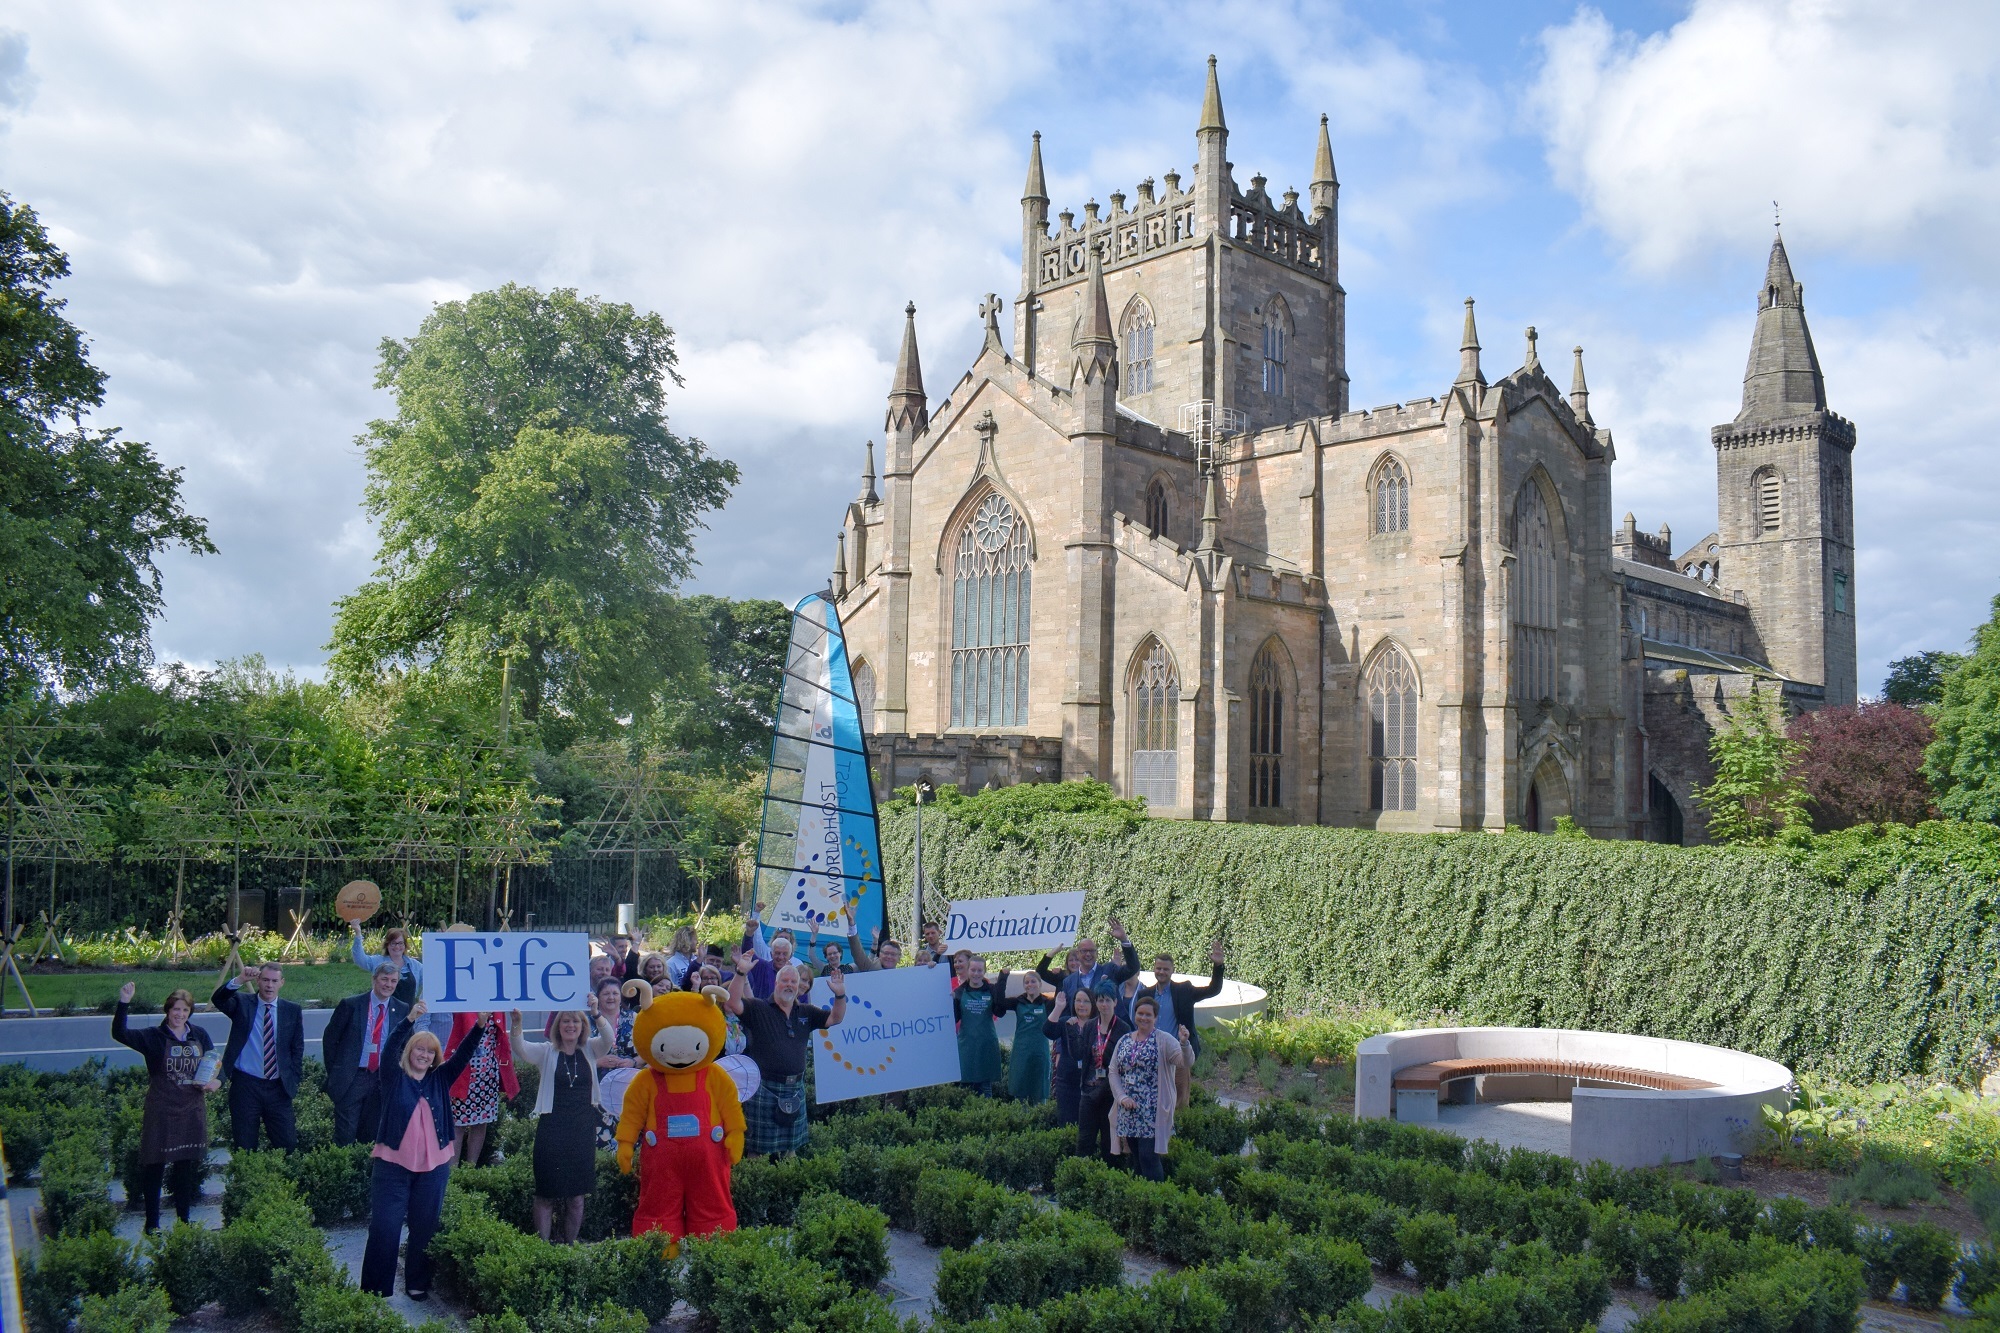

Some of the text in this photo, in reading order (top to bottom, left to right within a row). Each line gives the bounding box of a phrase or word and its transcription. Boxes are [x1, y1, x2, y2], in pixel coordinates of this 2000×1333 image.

[1041, 205, 1196, 284] ROBERT
[1230, 204, 1323, 271] THE
[820, 781, 843, 898] WORLDHOST
[946, 906, 1077, 941] Destination
[435, 936, 577, 1003] Fife
